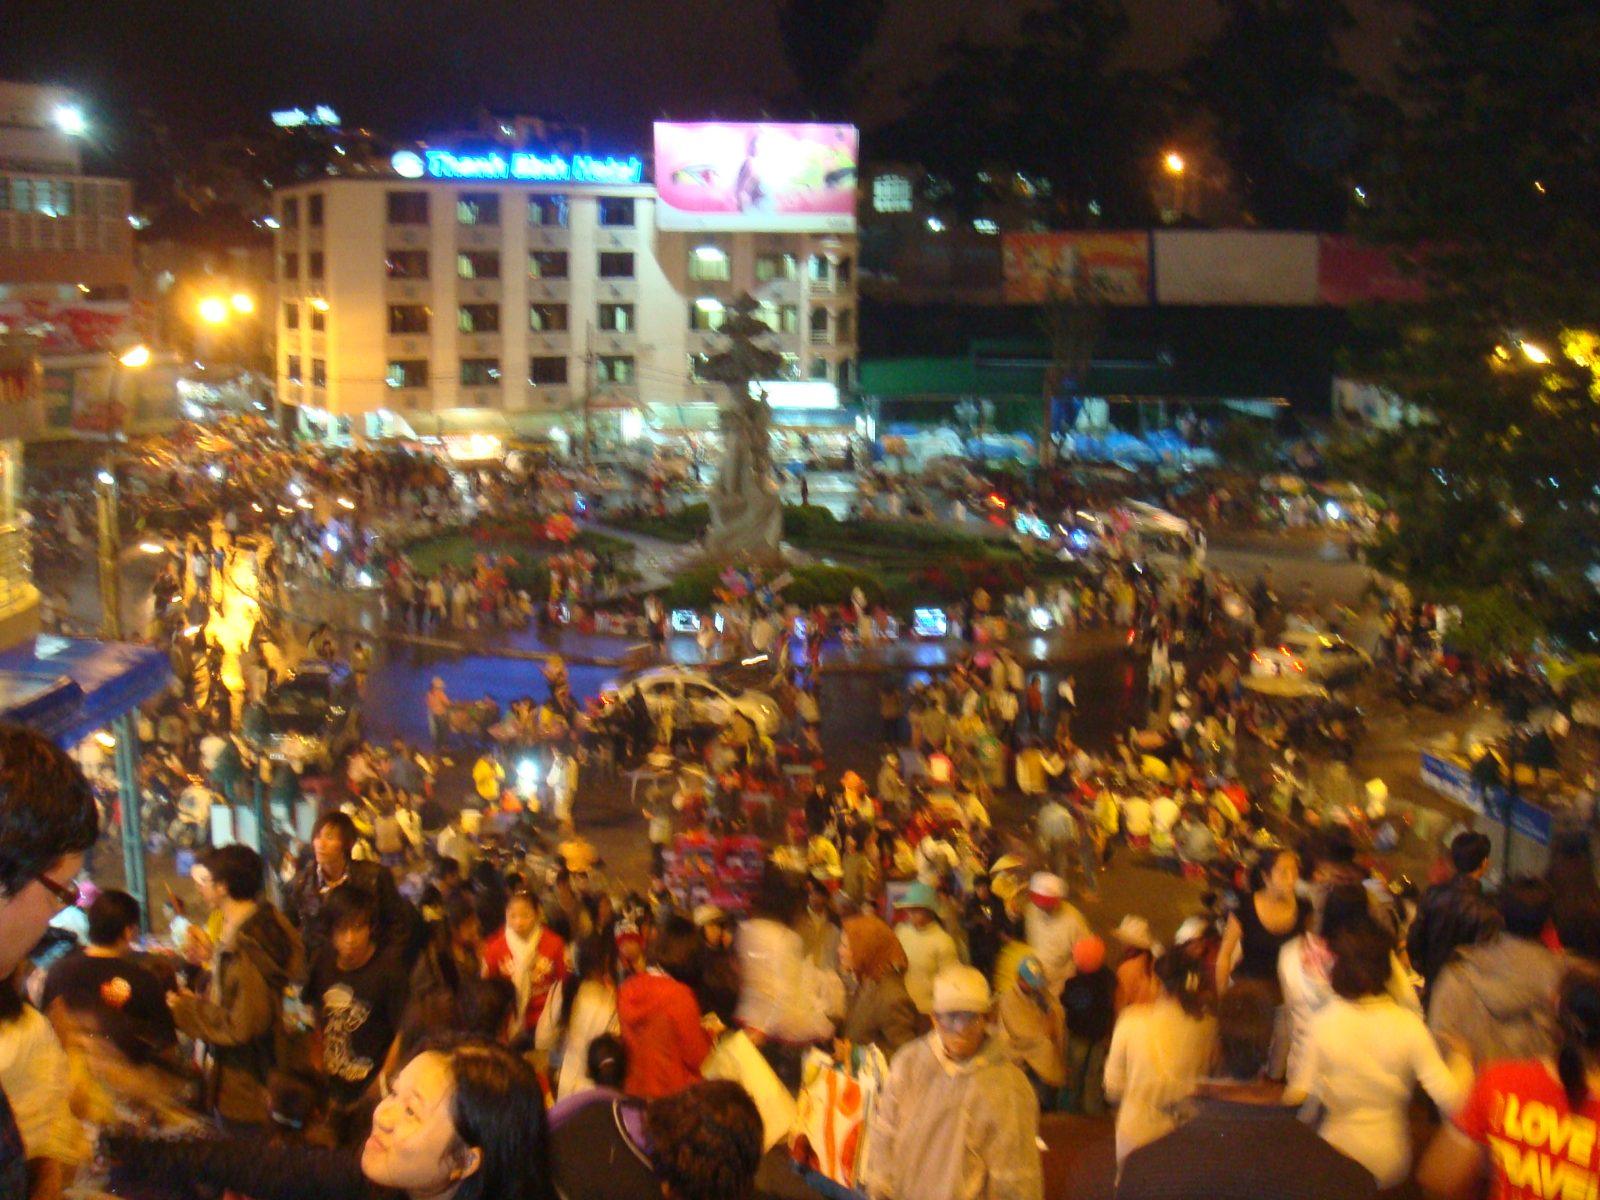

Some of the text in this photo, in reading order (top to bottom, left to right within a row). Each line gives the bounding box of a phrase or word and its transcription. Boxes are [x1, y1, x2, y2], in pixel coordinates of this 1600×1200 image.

[425, 150, 509, 179] Thanh
[571, 154, 643, 183] Hotel
[1503, 1091, 1597, 1168] LOVE
